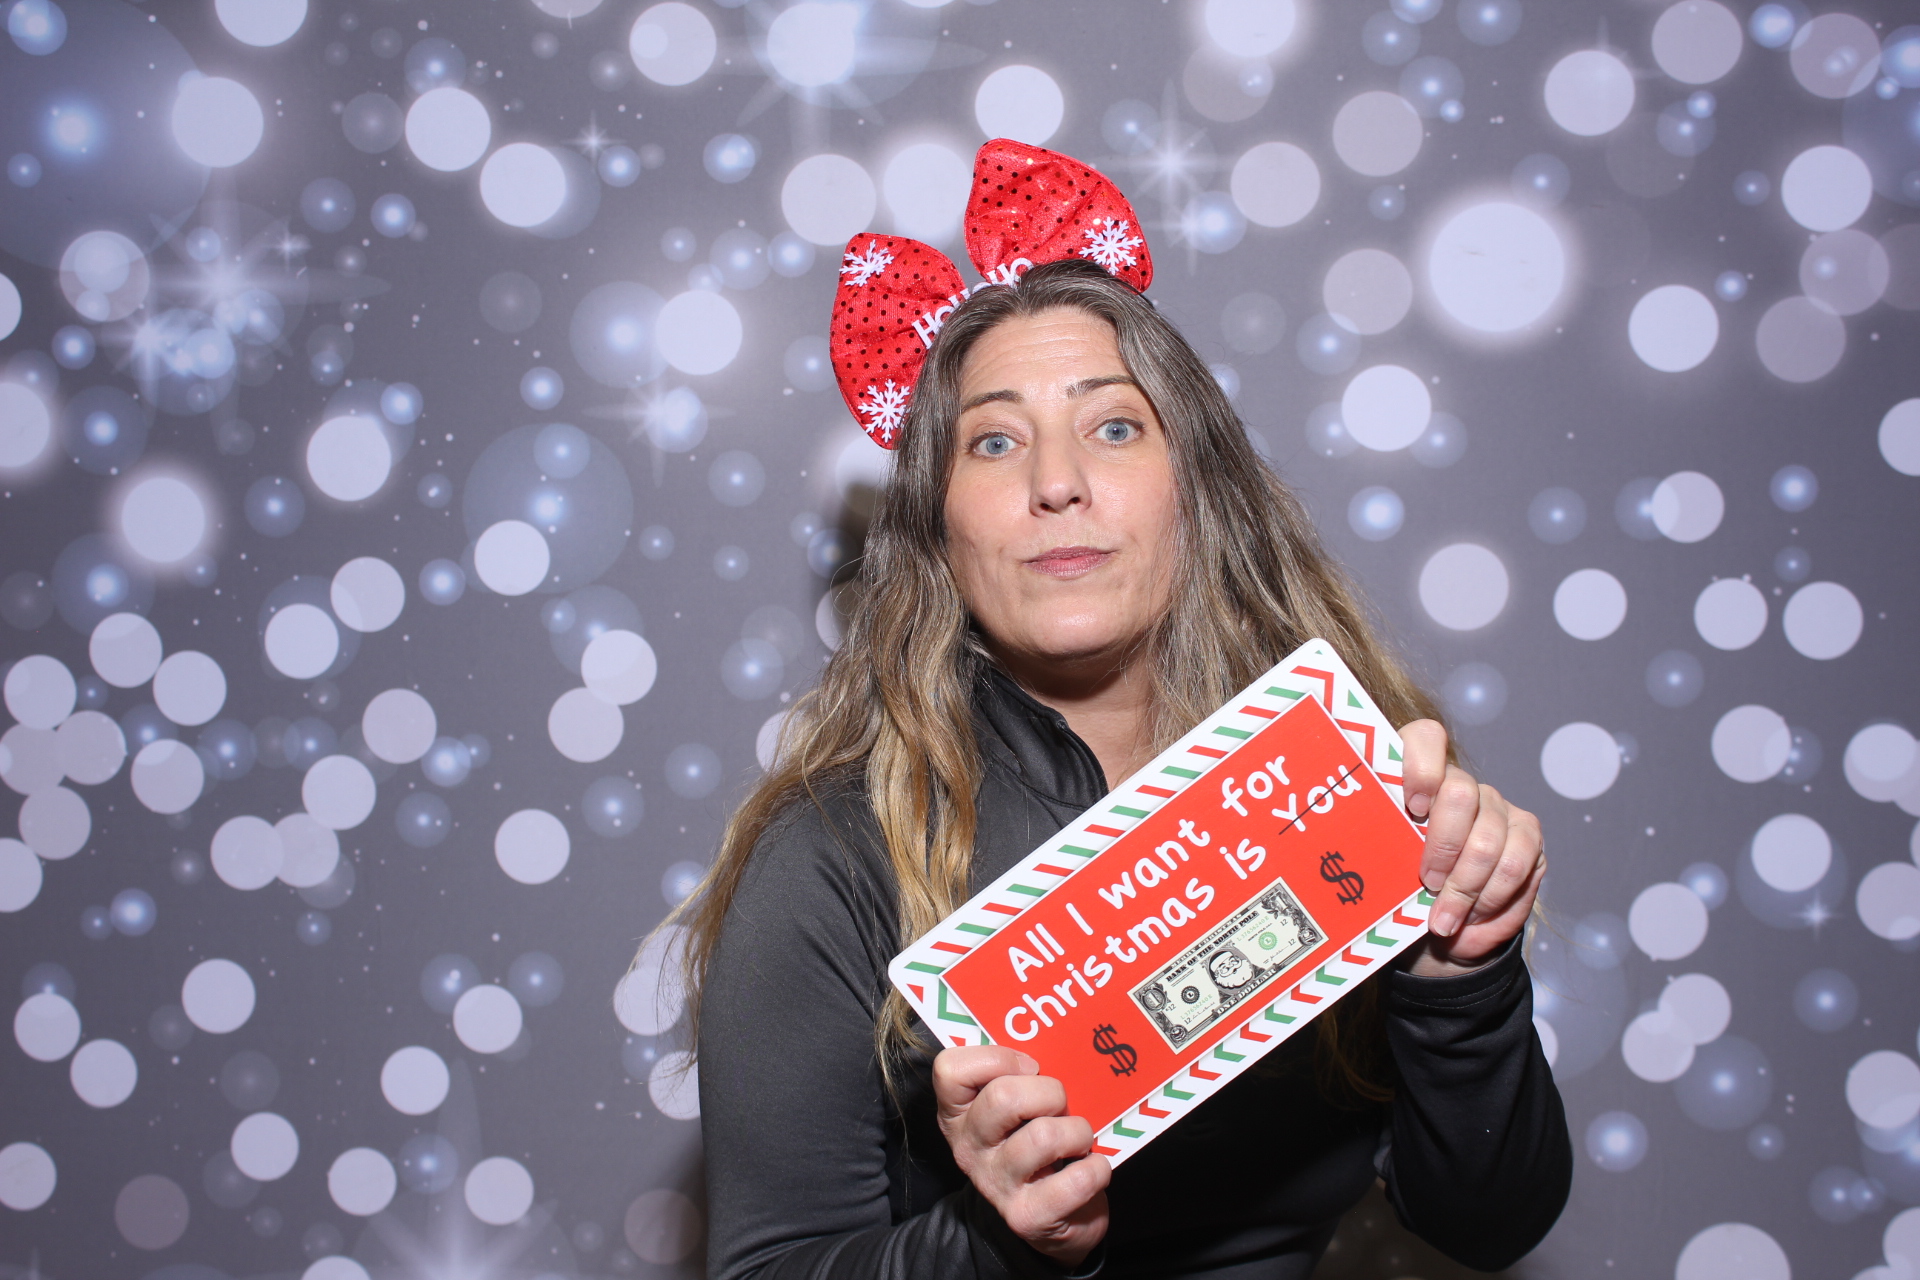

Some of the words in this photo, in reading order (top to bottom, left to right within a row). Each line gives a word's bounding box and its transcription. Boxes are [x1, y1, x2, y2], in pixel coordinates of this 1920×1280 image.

[1007, 923, 1064, 982] All
[1066, 903, 1094, 936] I
[1098, 819, 1210, 909] want
[1222, 755, 1290, 817] for
[1004, 877, 1215, 1041] Christmas
[1219, 838, 1266, 880] is
[1272, 765, 1362, 832] You
[1280, 919, 1288, 927] 12
[1165, 964, 1188, 983] BANK
[1186, 956, 1199, 967] OF
[1197, 944, 1215, 959] THE
[1212, 924, 1241, 948] NORTH
[1238, 910, 1259, 928] POLE
[1288, 938, 1296, 946] 12
[1216, 997, 1238, 1016] ONE
[1237, 967, 1277, 1000] DOLLAR
[1184, 1017, 1192, 1025] 12
